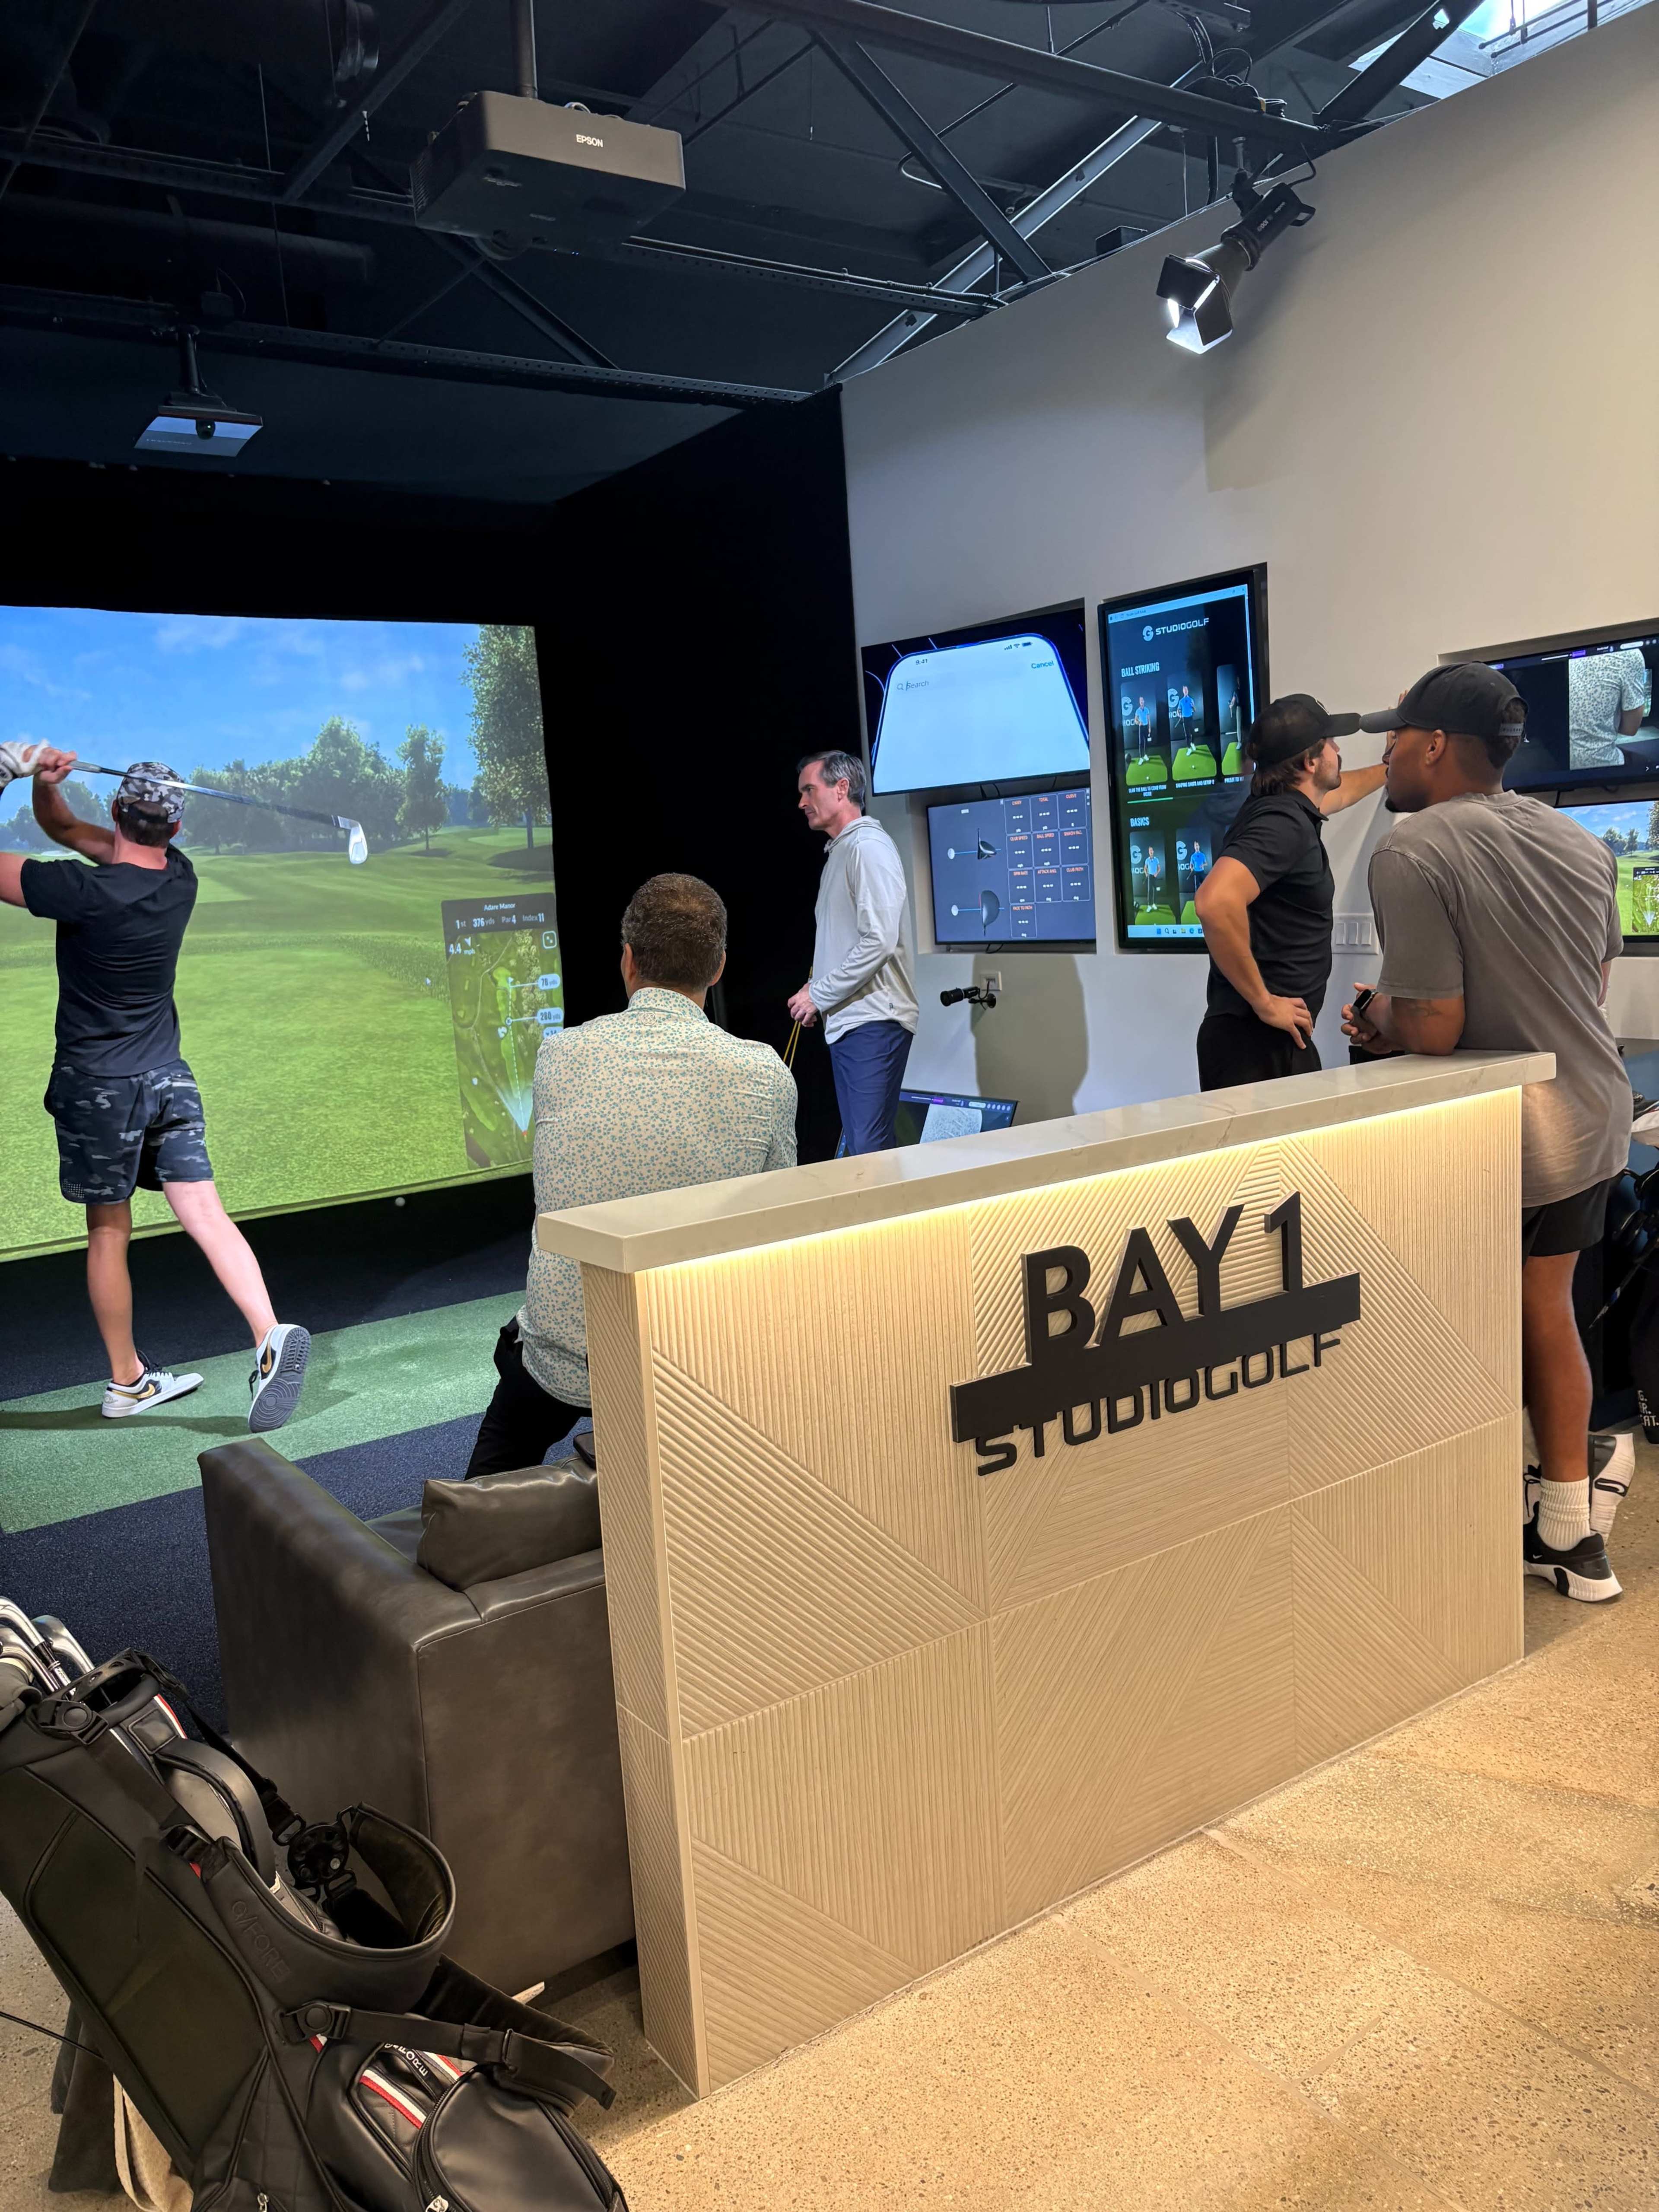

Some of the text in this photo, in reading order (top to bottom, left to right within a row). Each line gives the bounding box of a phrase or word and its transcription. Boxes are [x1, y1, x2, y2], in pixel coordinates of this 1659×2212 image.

[576, 134, 603, 147] EPSON
[1156, 617, 1209, 635] STUDIOGOLF
[1031, 660, 1054, 669] Cancel
[1121, 662, 1160, 677] BALL STRIKING
[907, 680, 929, 689] Search
[1130, 817, 1149, 827] BASICS
[473, 918, 485, 928] 376
[485, 918, 495, 926] yds
[511, 915, 516, 924] 4
[538, 913, 544, 923] 11
[449, 943, 462, 954] 4.4
[1021, 1191, 1302, 1365] BAY 1
[976, 1325, 1342, 1476] STUDIOGOLF
